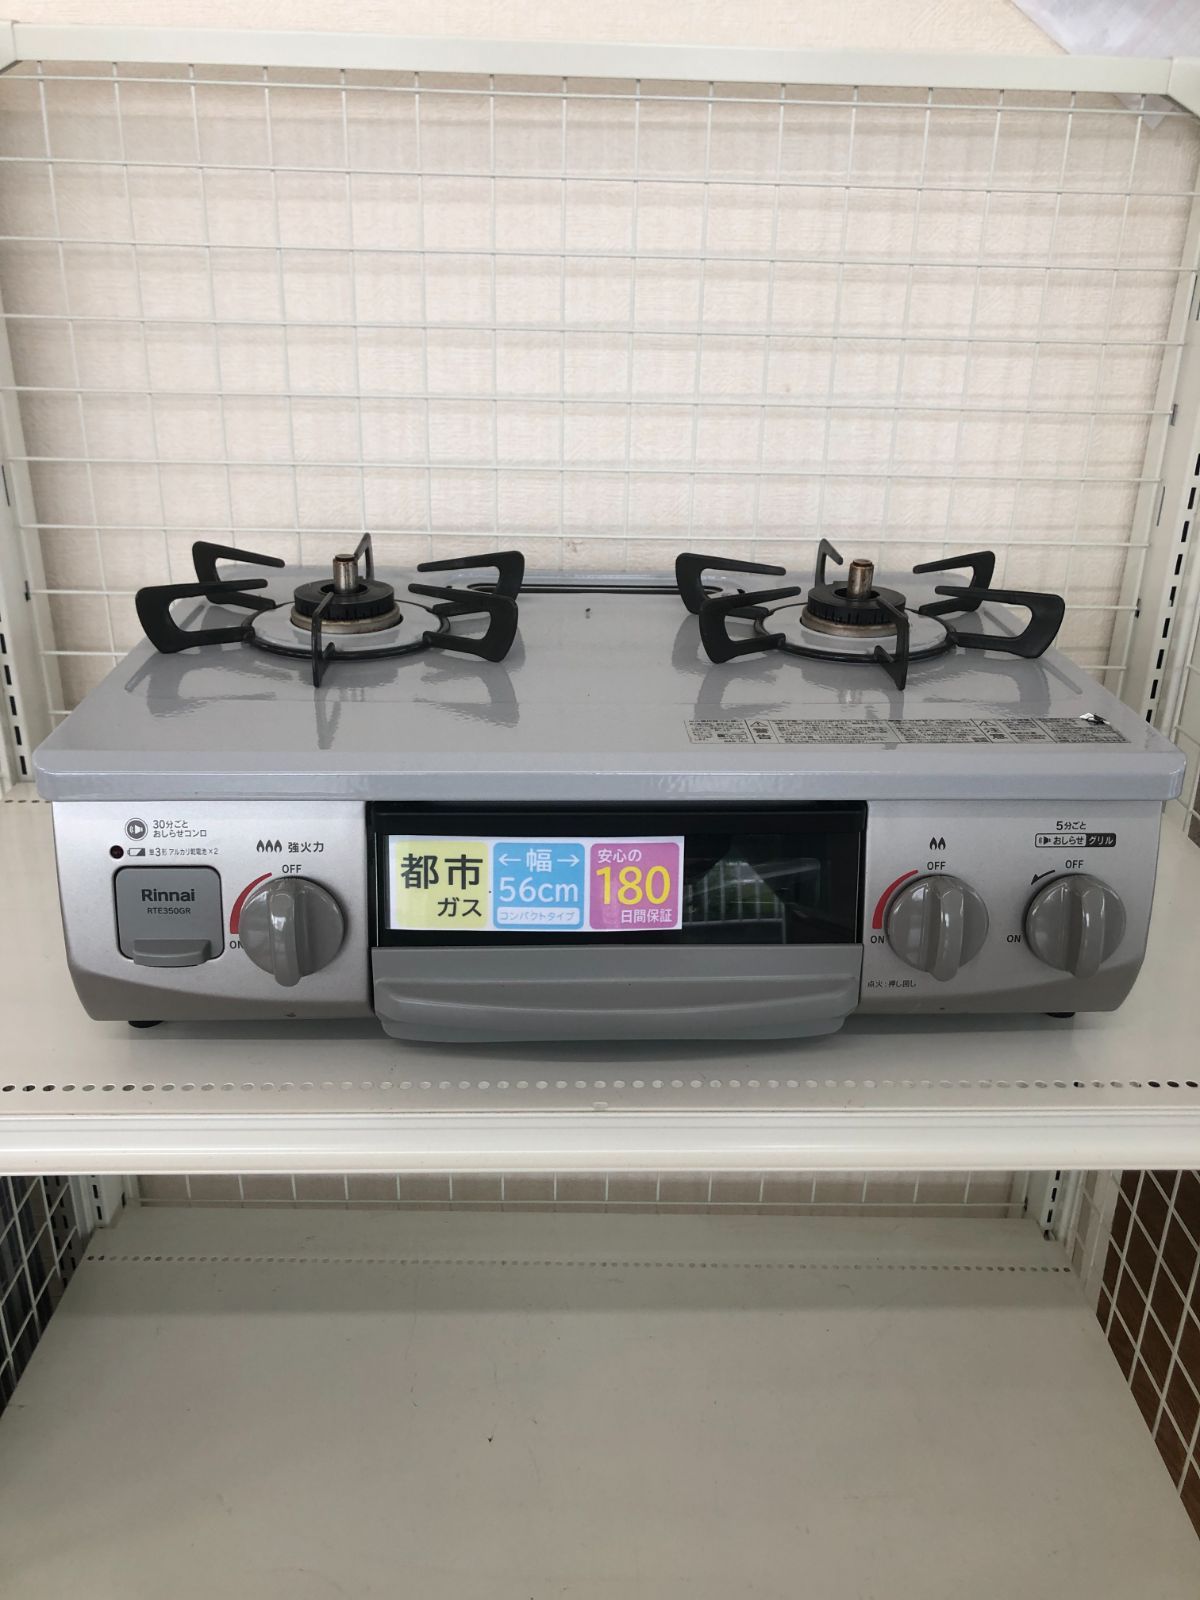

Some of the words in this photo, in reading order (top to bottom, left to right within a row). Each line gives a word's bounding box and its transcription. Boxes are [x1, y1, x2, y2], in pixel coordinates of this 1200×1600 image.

[153, 820, 188, 829] 30分ごと
[1056, 821, 1087, 830] 5分ごと
[153, 829, 207, 838] おしらせコンロ
[1053, 836, 1084, 846] おしらせ
[1089, 836, 1114, 845] グリル
[288, 841, 324, 853] 強火力
[526, 848, 552, 872] 幅
[598, 848, 642, 863] 安心の
[282, 864, 302, 874] OFF
[927, 861, 946, 871] OFF
[1065, 859, 1084, 869] OFF
[400, 853, 483, 890] 都市
[499, 876, 579, 903] 56cm
[596, 865, 671, 905] 180
[141, 888, 195, 902] Rinnai
[147, 907, 191, 915] RTE350GR
[437, 897, 482, 917] ガス
[500, 911, 576, 921] コンパクトタイプ
[621, 908, 673, 923] 日間保証
[870, 935, 885, 944] ON
[1006, 934, 1021, 943] ON
